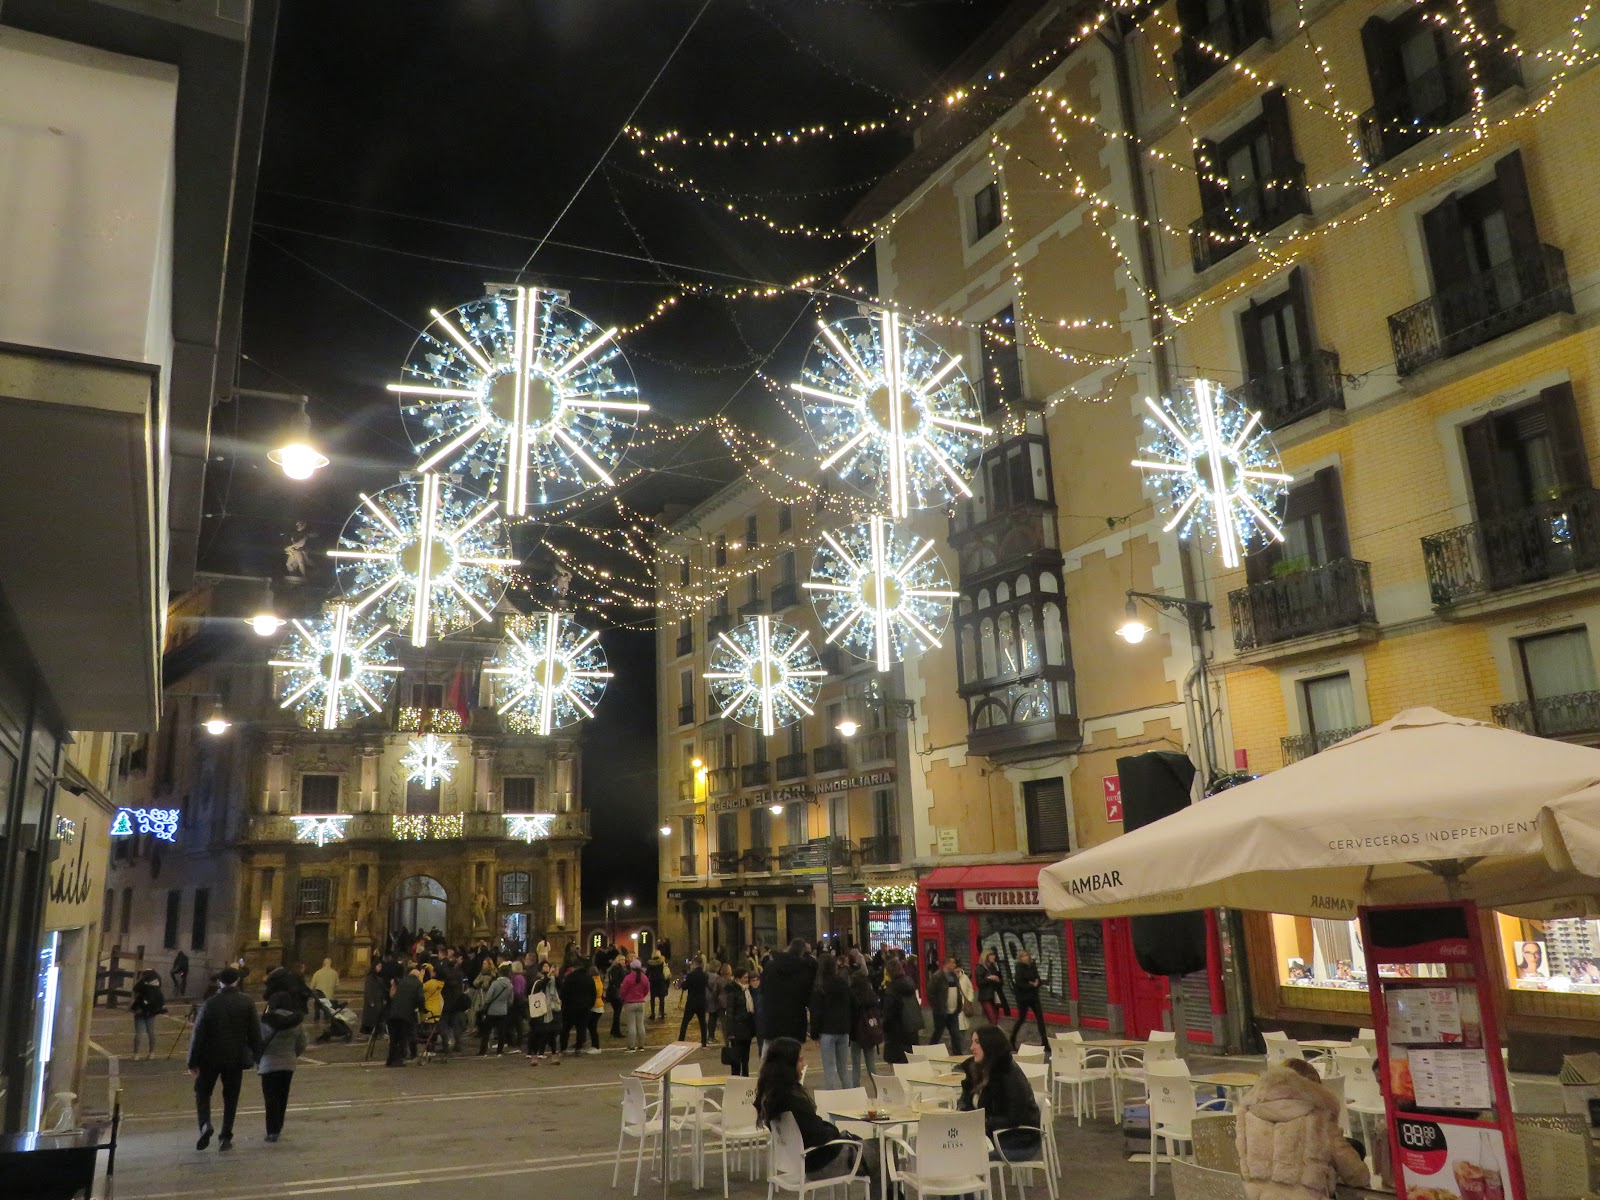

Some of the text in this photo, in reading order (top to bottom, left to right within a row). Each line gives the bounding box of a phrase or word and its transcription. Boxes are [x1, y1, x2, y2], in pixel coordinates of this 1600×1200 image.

[814, 772, 892, 794] INMOBILIARIA
[1328, 820, 1538, 851] CERVECEROS INDEPENDIENT
[1071, 870, 1124, 896] AMBAR
[975, 891, 1040, 906] GUTIERREZ
